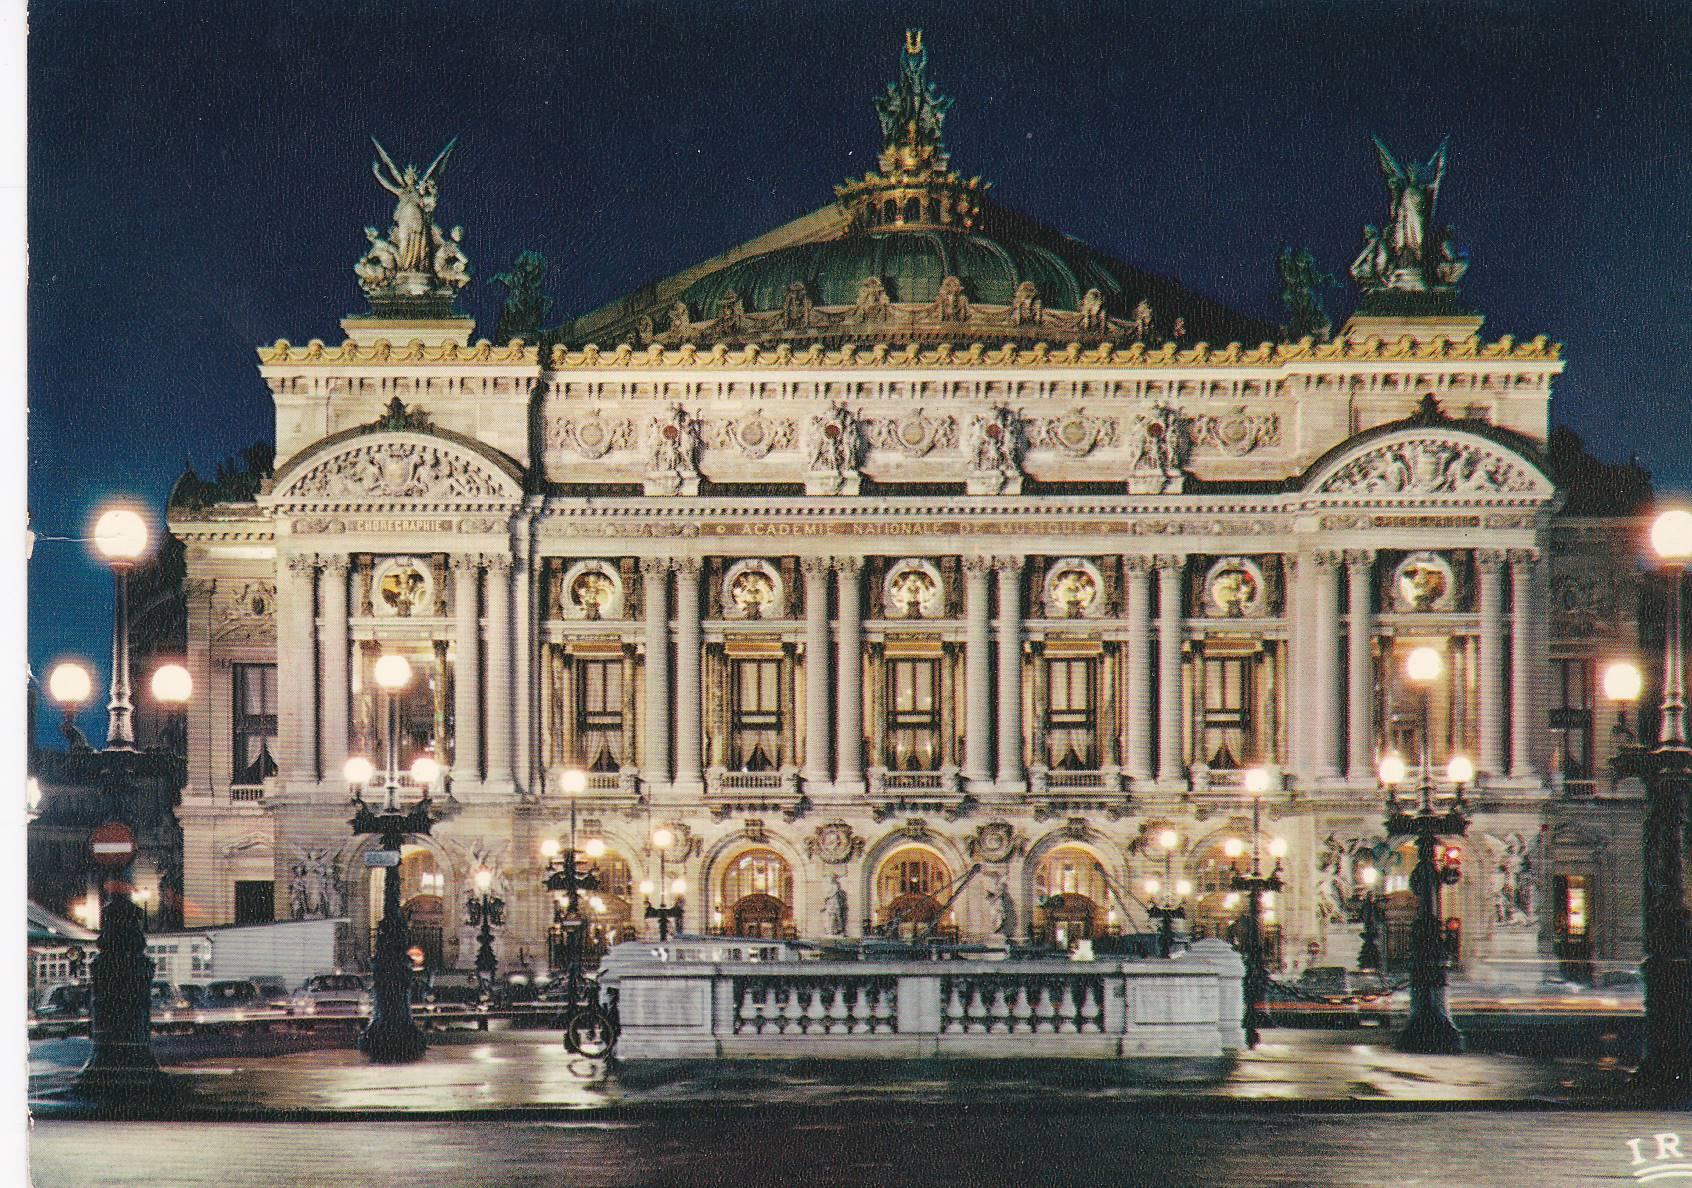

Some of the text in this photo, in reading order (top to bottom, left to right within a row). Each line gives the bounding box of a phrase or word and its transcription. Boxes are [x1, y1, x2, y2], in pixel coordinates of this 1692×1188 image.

[742, 522, 833, 534] ACADEMIE
[853, 522, 942, 534] NATIONALE
[1000, 522, 1084, 534] MUSIQUE
